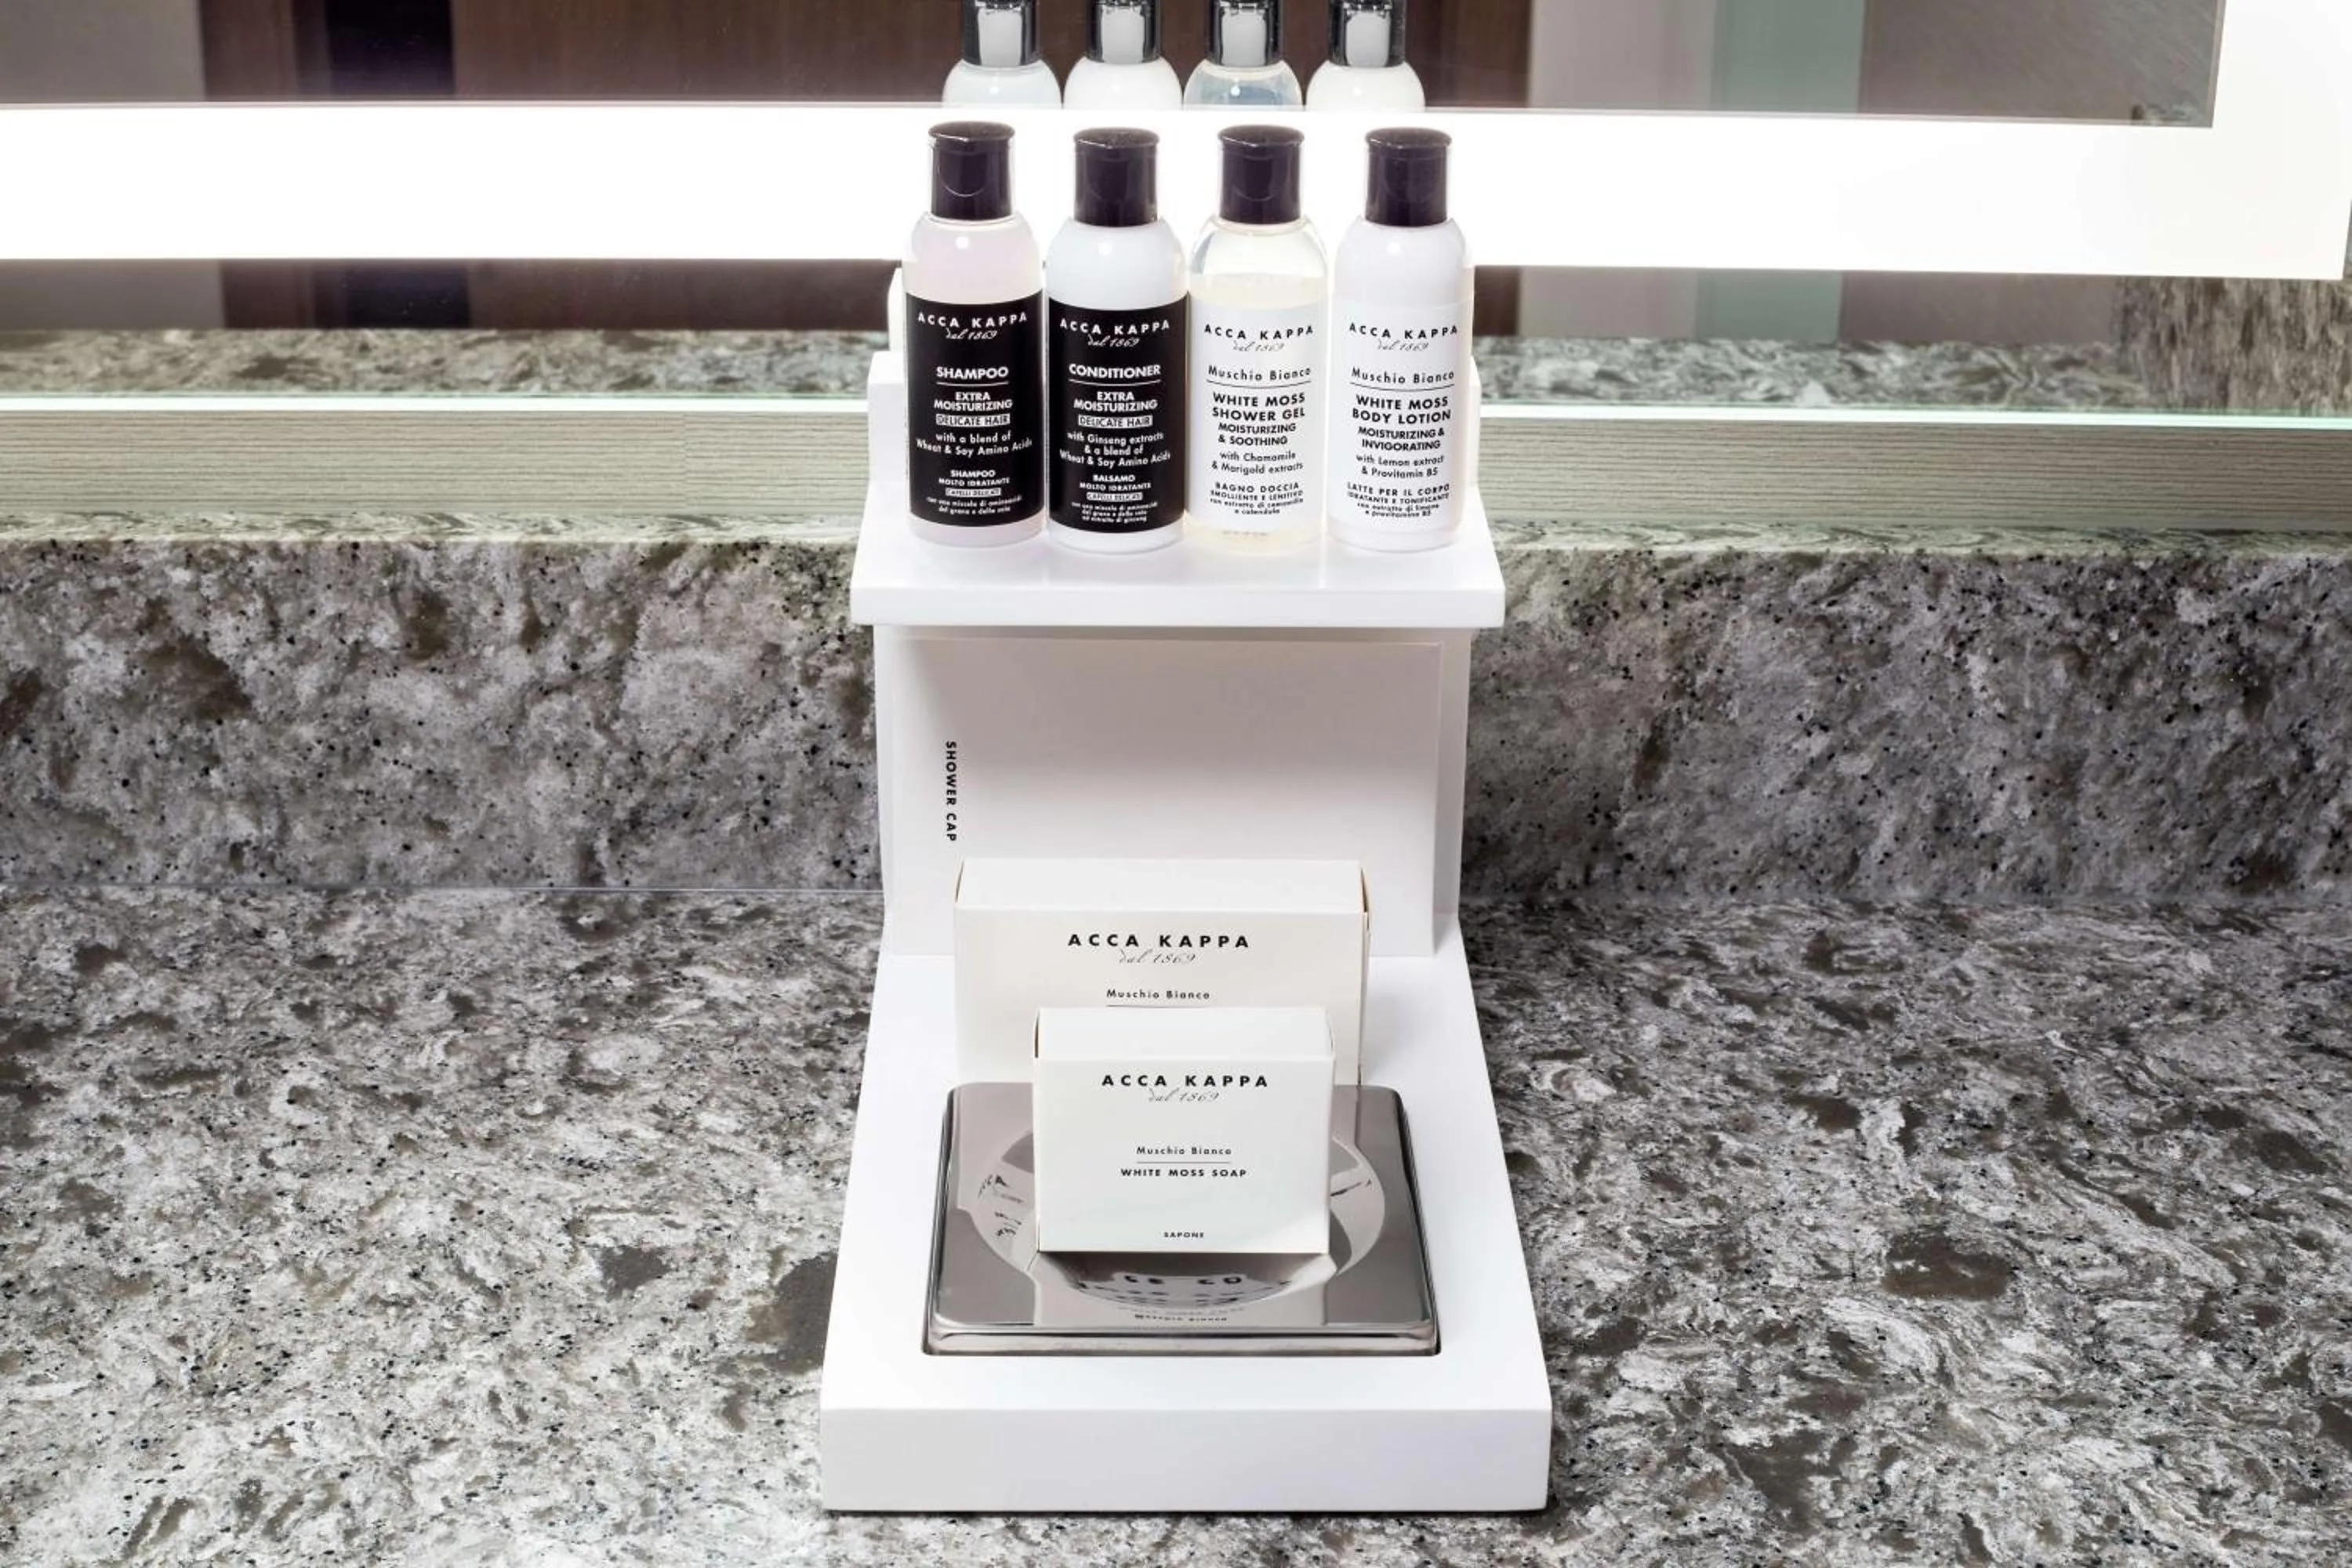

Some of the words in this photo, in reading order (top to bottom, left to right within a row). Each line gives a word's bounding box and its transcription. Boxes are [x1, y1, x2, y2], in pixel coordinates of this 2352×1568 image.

[918, 312, 960, 328] ACCA
[971, 312, 1027, 328] KAPPA
[1060, 318, 1102, 335] ACCA
[1114, 319, 1170, 336] KAPPA
[1204, 324, 1246, 339] ACCA
[1260, 325, 1313, 340] KAPPA
[1349, 322, 1391, 338] ACCA
[1404, 325, 1458, 339] KAPPA
[936, 366, 1009, 379] SHAMPOO
[1069, 363, 1161, 379] CONDITIONER
[1208, 365, 1262, 381] Muschio
[1269, 368, 1311, 381] Bianco
[1352, 367, 1406, 383] Muschio
[1413, 371, 1454, 383] Bianco
[955, 391, 991, 401] EXTRA
[1097, 391, 1134, 401] EXTRA
[1213, 391, 1258, 407] WHITE
[1265, 392, 1305, 407] MOSS
[1356, 394, 1402, 410] WHITE
[1408, 396, 1448, 410] MOSS
[934, 399, 1013, 412] MOISTURIZING
[1073, 399, 1158, 412] MOISTURIZING
[938, 415, 981, 426] DELICATE
[984, 415, 1009, 425] HAIR
[1212, 407, 1276, 421] SHOWER
[1282, 408, 1305, 420] GEL
[1352, 408, 1392, 423] BODY
[1398, 409, 1450, 424] LOTION
[1080, 416, 1123, 427] DELICATE
[1127, 416, 1150, 427] HAIR
[1218, 423, 1296, 434] MOISTURIZING
[1358, 426, 1436, 439] MOISTURIZING
[1438, 427, 1445, 437] &
[936, 432, 956, 443] with
[970, 433, 998, 444] blend
[1001, 430, 1011, 441] of
[1067, 431, 1084, 442] with
[1087, 434, 1126, 447] Ginseng
[1130, 432, 1164, 444] extracts
[1218, 434, 1225, 443] &
[1229, 435, 1288, 446] SOOTHING
[916, 437, 942, 452] Wheat
[945, 445, 952, 454] &
[956, 446, 974, 458] Soy
[978, 445, 1009, 456] Amino
[1011, 437, 1033, 452] Acids
[1084, 445, 1091, 454] &
[1104, 445, 1131, 456] blend
[1133, 445, 1144, 455] of
[1362, 439, 1441, 451] INVIGORATING
[1060, 449, 1084, 464] Wheat
[1087, 456, 1094, 465] &
[1098, 457, 1114, 469] Soy
[1118, 457, 1149, 466] Amino
[1150, 450, 1171, 463] Acids
[1219, 451, 1240, 461] with
[1243, 450, 1296, 462] Chamomile
[1356, 455, 1374, 464] with
[1378, 457, 1410, 466] Lemon
[1414, 456, 1444, 466] extract
[1211, 460, 1218, 470] &
[1221, 463, 1265, 475] Marigold
[1268, 463, 1303, 474] extracts
[1361, 466, 1368, 475] &
[1372, 467, 1424, 478] Provitamin
[1427, 467, 1438, 477] B5
[938, 477, 965, 486] MOLTO
[967, 477, 1010, 486] IDRATANTE
[1109, 482, 1152, 491] IDRATANTE
[1215, 481, 1254, 492] BAGNO
[1260, 482, 1299, 492] DOCCIA
[1210, 490, 1258, 501] EMOLLIENTE
[1348, 482, 1373, 494] LATTE
[1417, 484, 1450, 496] CORPO
[1348, 492, 1388, 503] IDRATANTE
[1400, 493, 1450, 504] TONIFICANTE
[946, 741, 957, 806] SHOWER
[946, 813, 957, 841] CAP
[1068, 934, 1139, 947] ACCA
[1160, 935, 1249, 948] KAPPA
[1119, 948, 1153, 964] dal
[1152, 953, 1196, 964] 1869
[1106, 989, 1160, 1000] Muschio
[1166, 990, 1210, 1000] Bianco
[1102, 1075, 1167, 1087] ACCA
[1185, 1075, 1268, 1087] KAPPA
[1149, 1087, 1179, 1102] dal
[1179, 1091, 1220, 1103] 1869
[1136, 1146, 1185, 1156] Muschio
[1191, 1147, 1232, 1156] Bianco
[1120, 1168, 1161, 1177] WHITE
